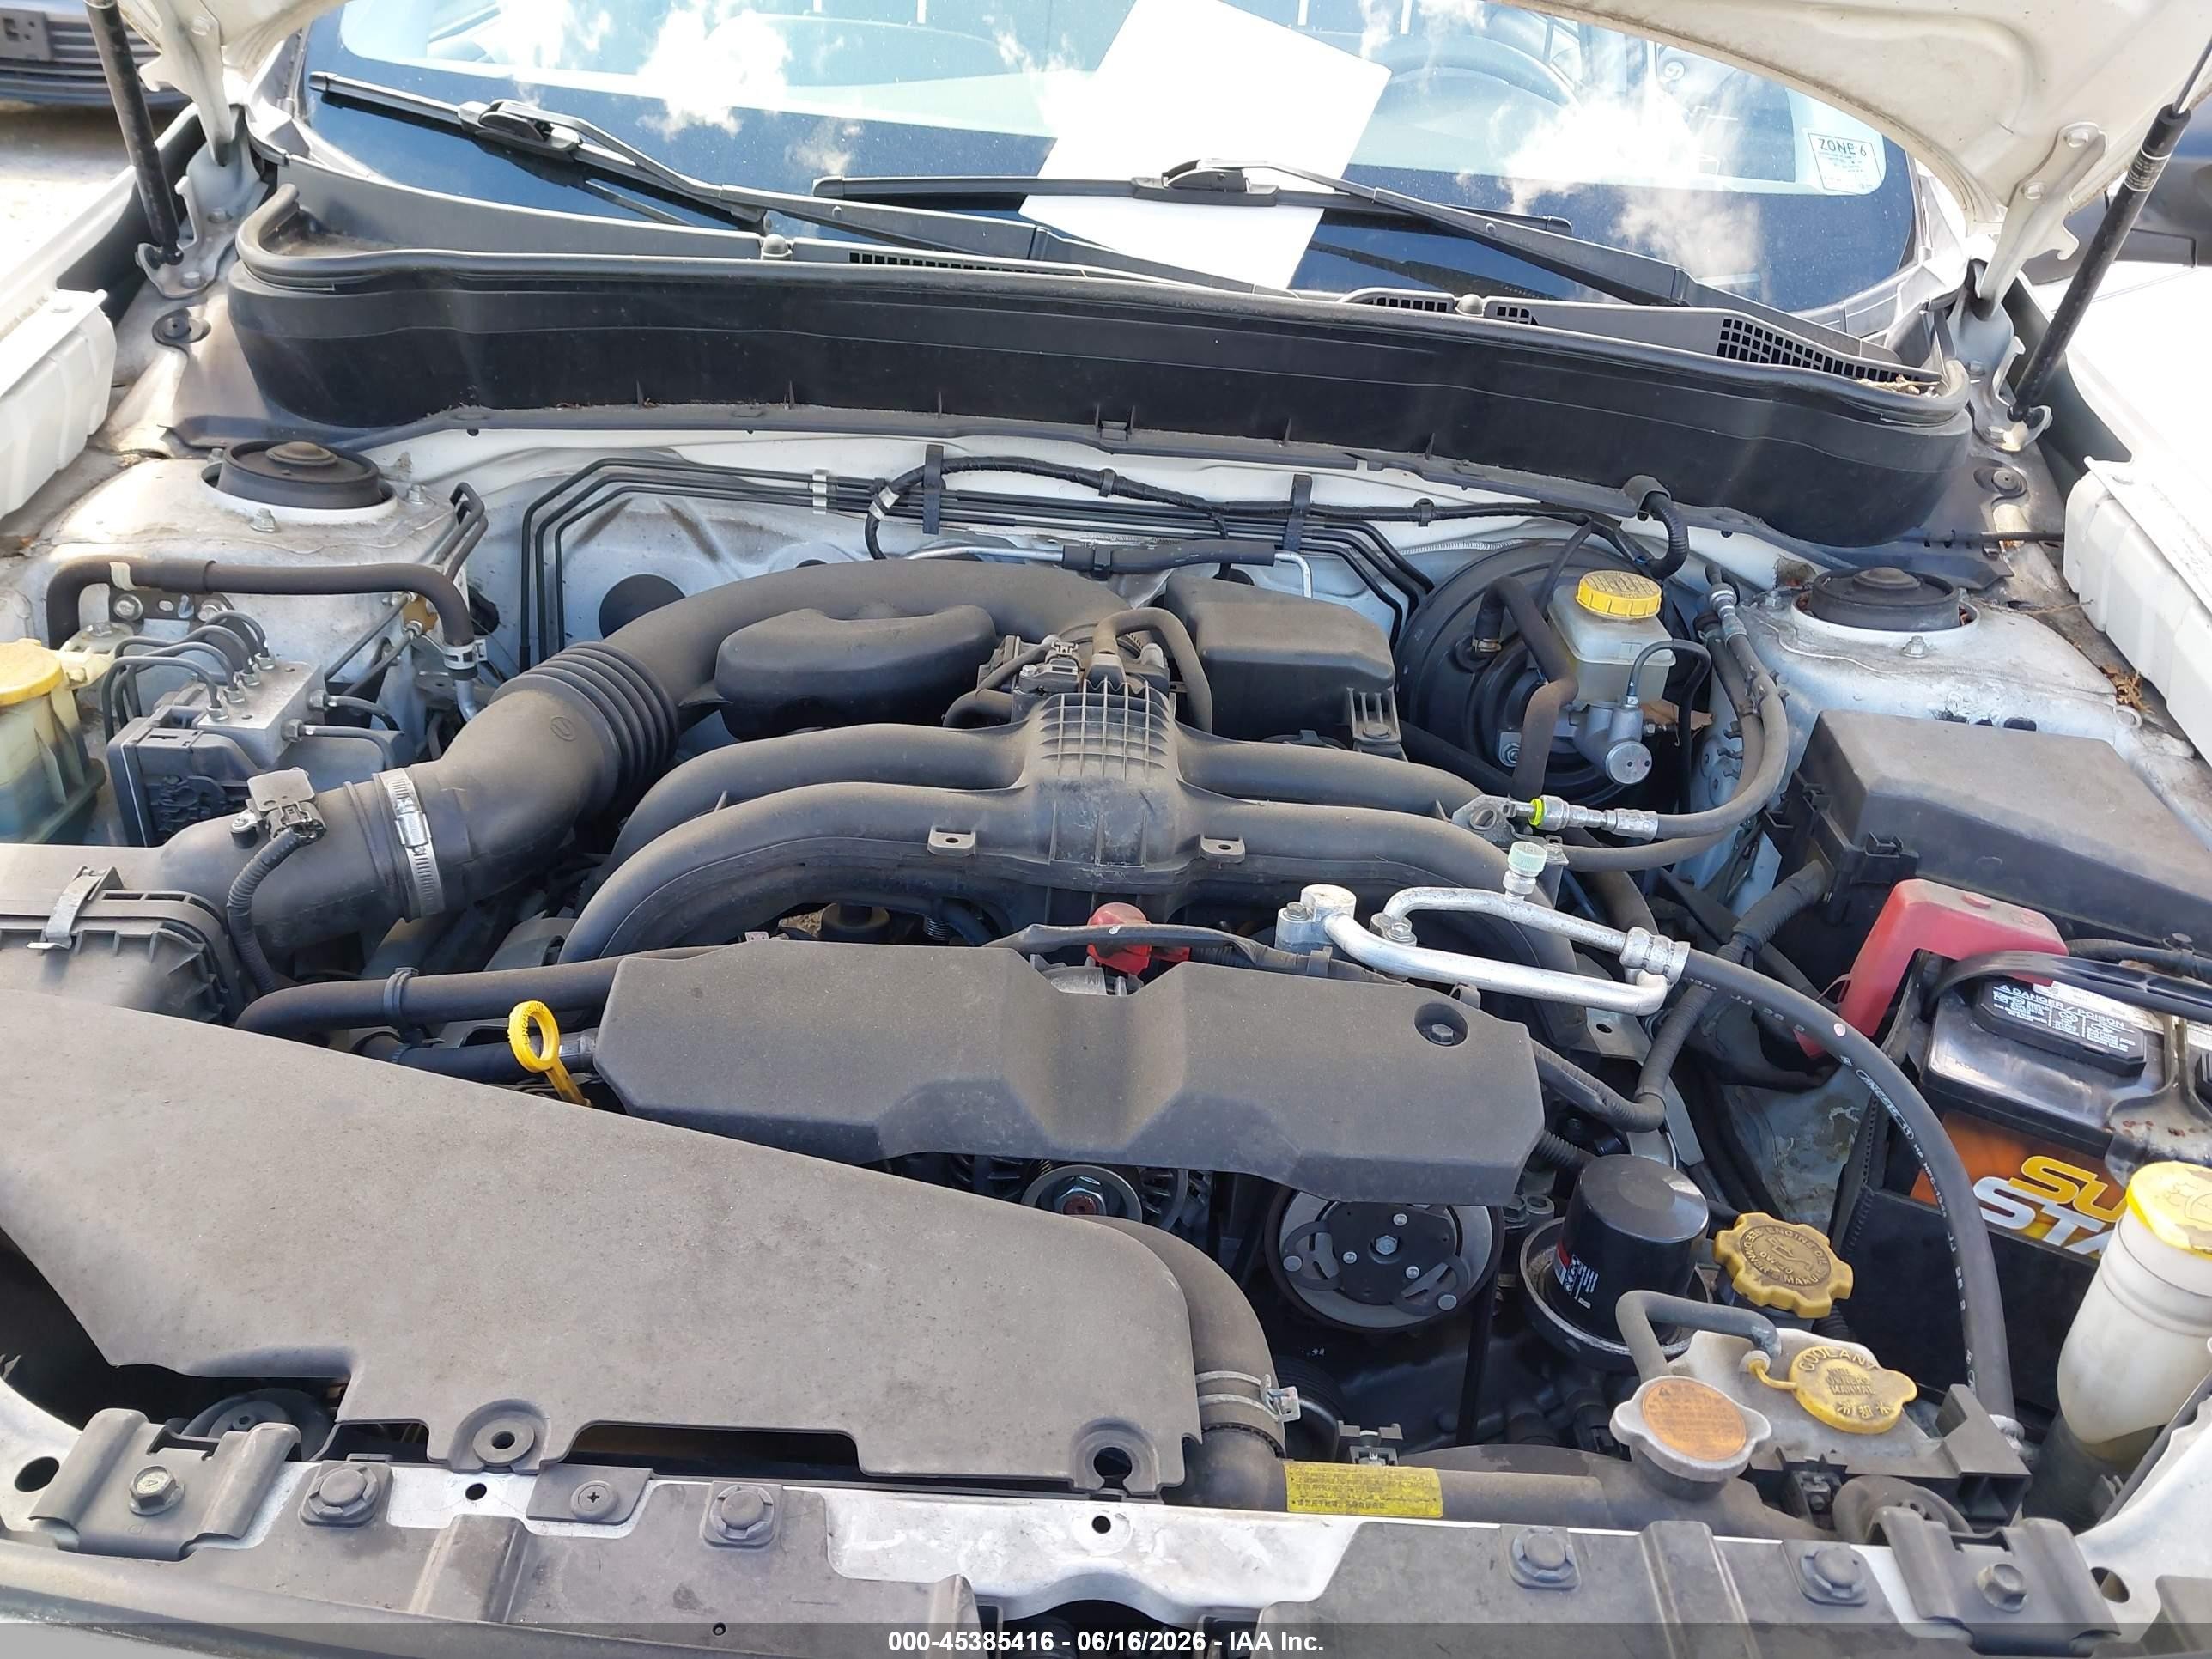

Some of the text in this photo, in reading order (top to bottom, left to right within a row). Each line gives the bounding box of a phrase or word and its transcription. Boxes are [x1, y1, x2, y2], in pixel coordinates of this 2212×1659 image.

[1818, 138, 1868, 157] ZONE 6
[2011, 987, 2064, 1010] DANGER
[2077, 1008, 2125, 1029] POISON
[1766, 1226, 1817, 1250] ENGINE
[1798, 1347, 1879, 1373] COOLANT
